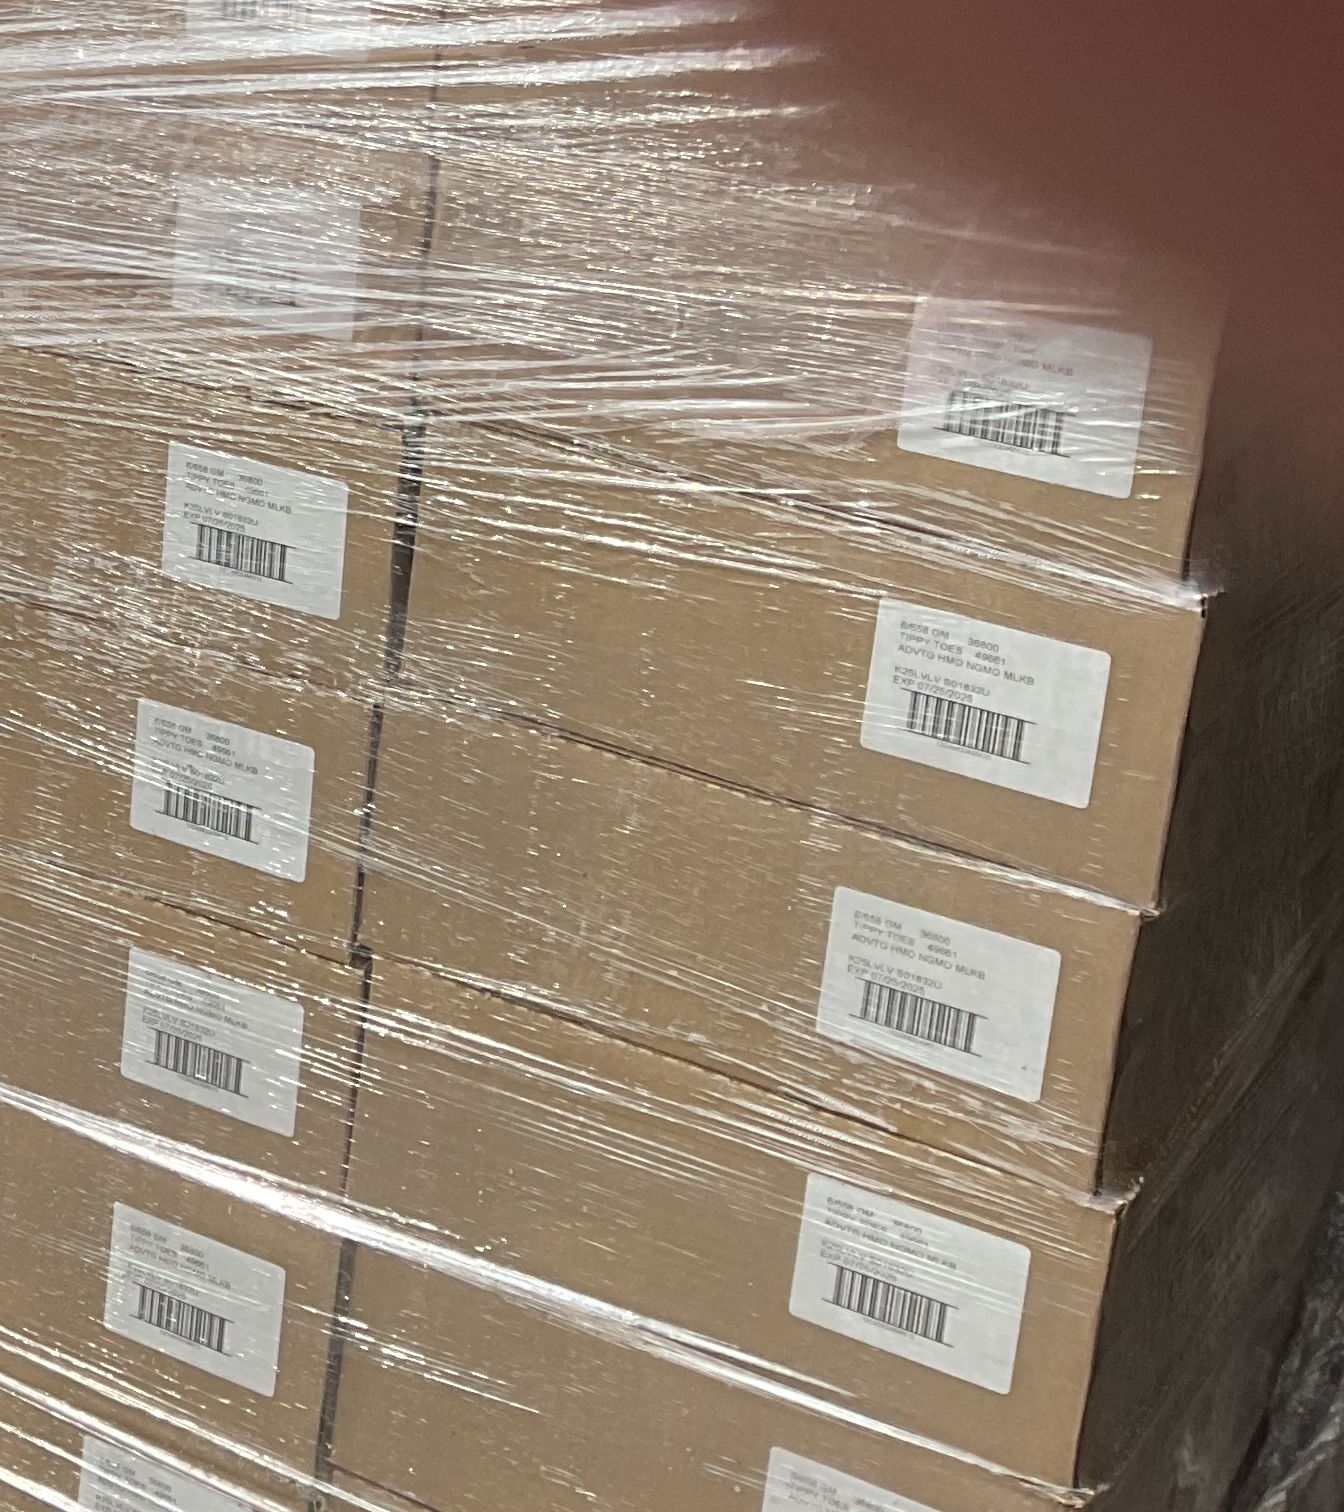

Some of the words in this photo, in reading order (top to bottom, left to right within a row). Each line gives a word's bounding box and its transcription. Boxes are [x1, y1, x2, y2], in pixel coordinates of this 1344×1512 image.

[900, 631, 930, 645] TIPPY
[935, 640, 963, 655] TOES
[898, 644, 936, 660] ADVTG
[966, 660, 1001, 677] NGMO
[1003, 670, 1035, 686] MLKB
[893, 675, 915, 686] EXP
[855, 921, 885, 936] TIPPY
[887, 931, 915, 946] TOES
[851, 933, 888, 950] ADVTG
[890, 944, 916, 959] HMO
[918, 952, 952, 970] NGMO
[955, 963, 986, 980] MLKB
[847, 964, 869, 977] EXP
